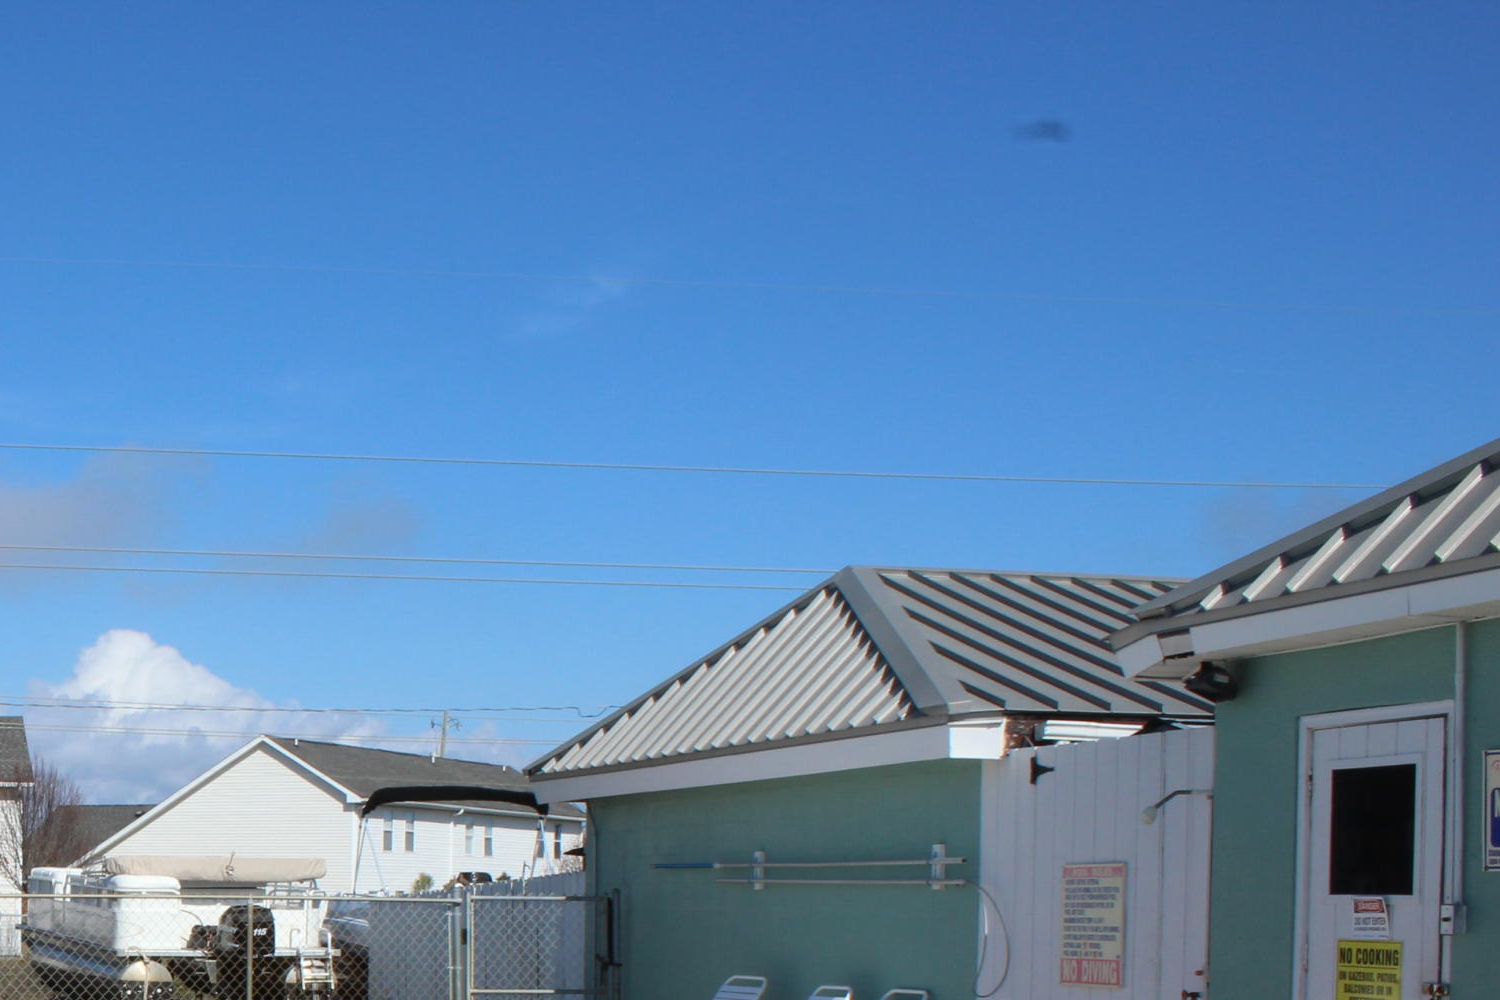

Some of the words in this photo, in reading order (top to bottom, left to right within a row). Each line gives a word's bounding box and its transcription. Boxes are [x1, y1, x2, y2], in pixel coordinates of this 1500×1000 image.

[253, 928, 268, 936] 115
[1339, 947, 1353, 964] NO
[1356, 948, 1399, 966] COOKING
[1063, 960, 1077, 982] NO
[1082, 961, 1117, 983] DIVING
